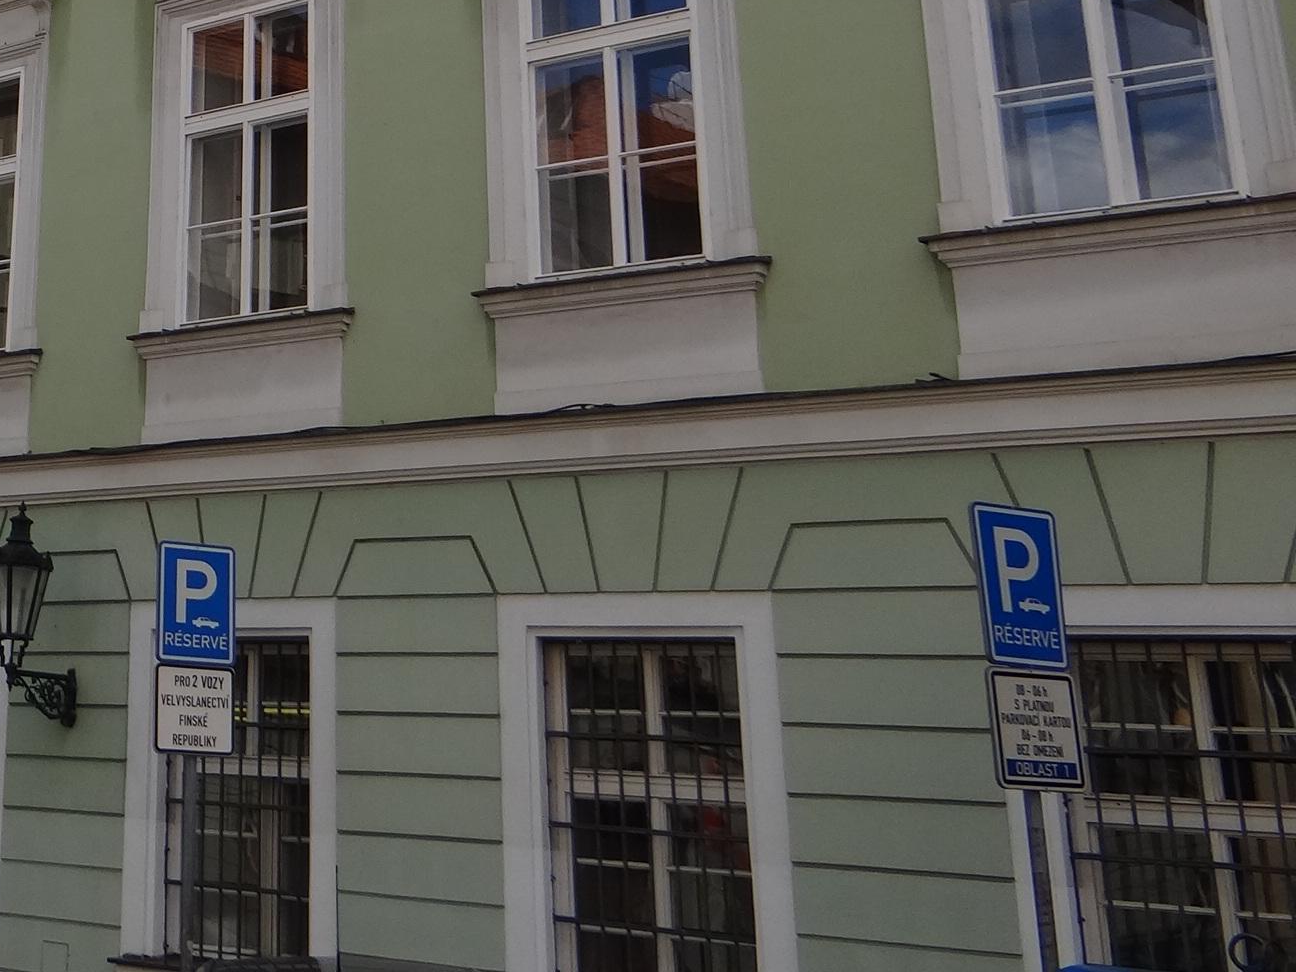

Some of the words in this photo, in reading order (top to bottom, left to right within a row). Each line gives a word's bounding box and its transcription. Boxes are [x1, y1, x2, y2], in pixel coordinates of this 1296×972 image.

[992, 526, 1039, 613] P
[176, 558, 217, 623] P
[164, 630, 229, 650] RÉSERVÉ
[994, 623, 1060, 649] RÉSERVÉ
[174, 674, 191, 688] PRO
[192, 674, 198, 688] 2
[201, 675, 224, 690] VOZY
[161, 693, 230, 709] VELVYSLANECTVÍ
[1014, 698, 1020, 710] S
[179, 711, 209, 728] FINSKÉ
[172, 733, 217, 748] REPUBLIKY
[1015, 761, 1058, 777] OBLAST
[1064, 765, 1070, 778] 1
